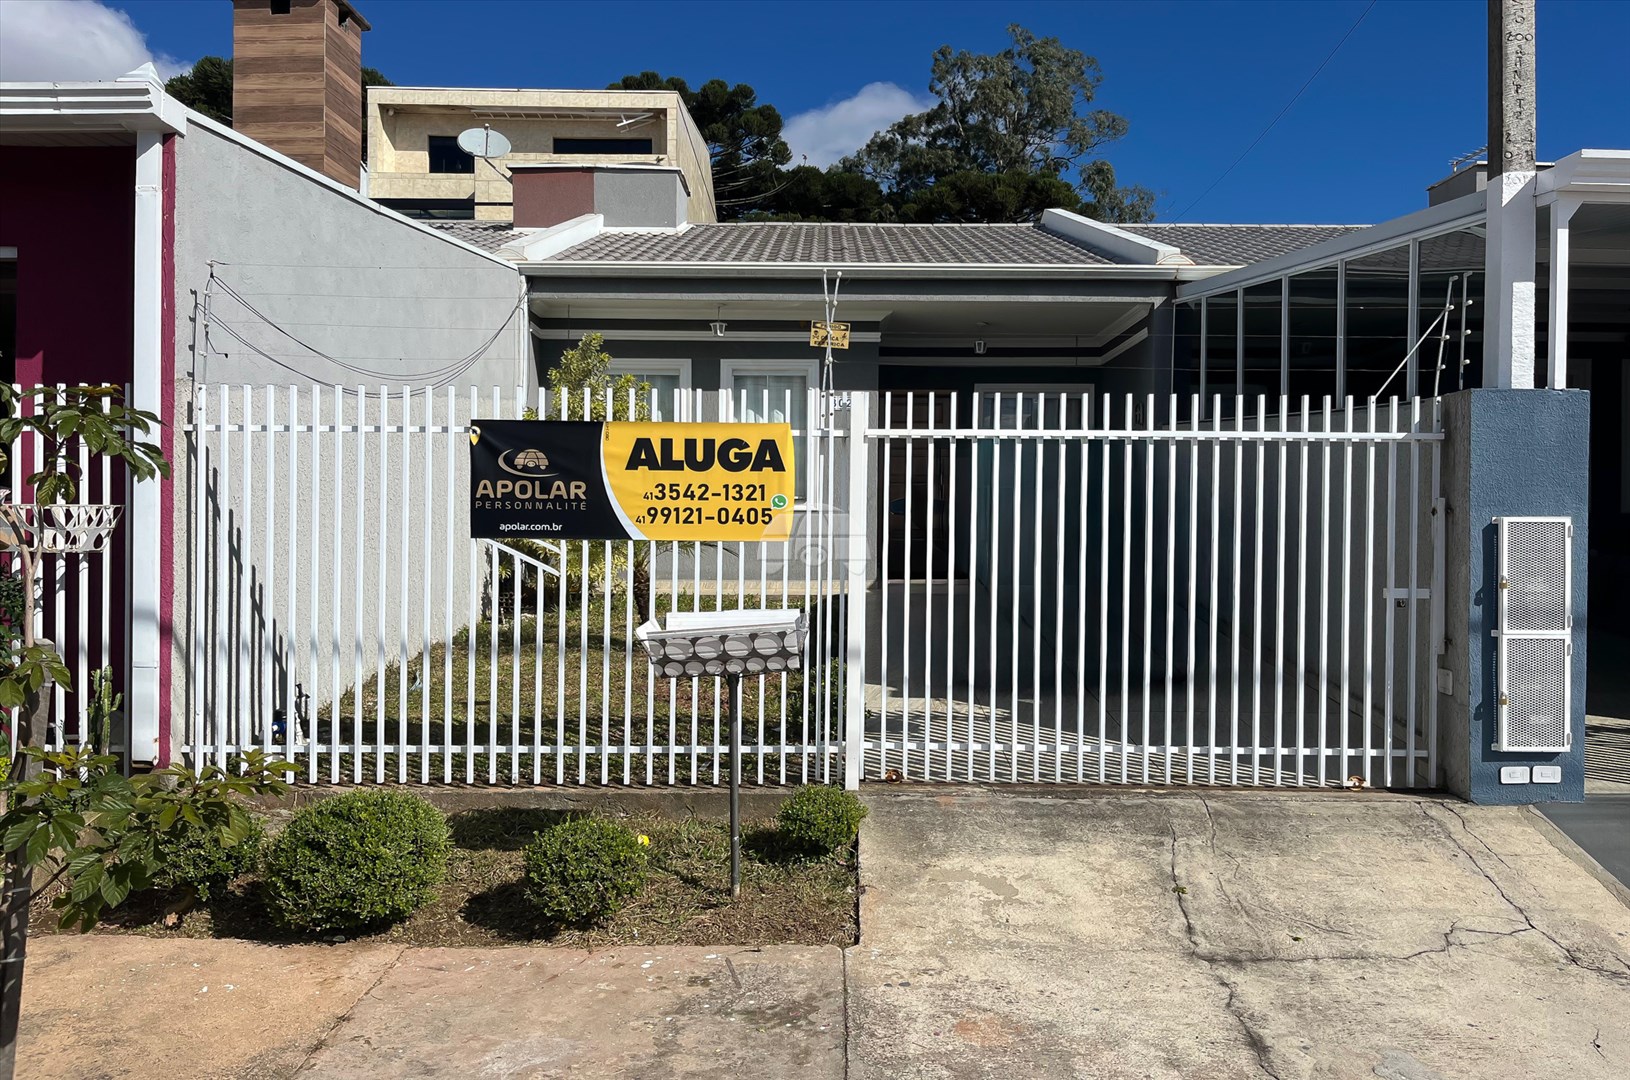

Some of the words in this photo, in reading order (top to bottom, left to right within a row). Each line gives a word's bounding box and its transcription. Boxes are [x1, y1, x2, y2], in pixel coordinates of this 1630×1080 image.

[625, 437, 786, 473] ALUGA
[475, 479, 588, 500] APOLAR
[654, 483, 766, 501] 3542-1321
[475, 501, 587, 511] PERSONNALITÉ
[646, 507, 773, 525] 99121-0405
[499, 522, 563, 532] apolar.com.br
